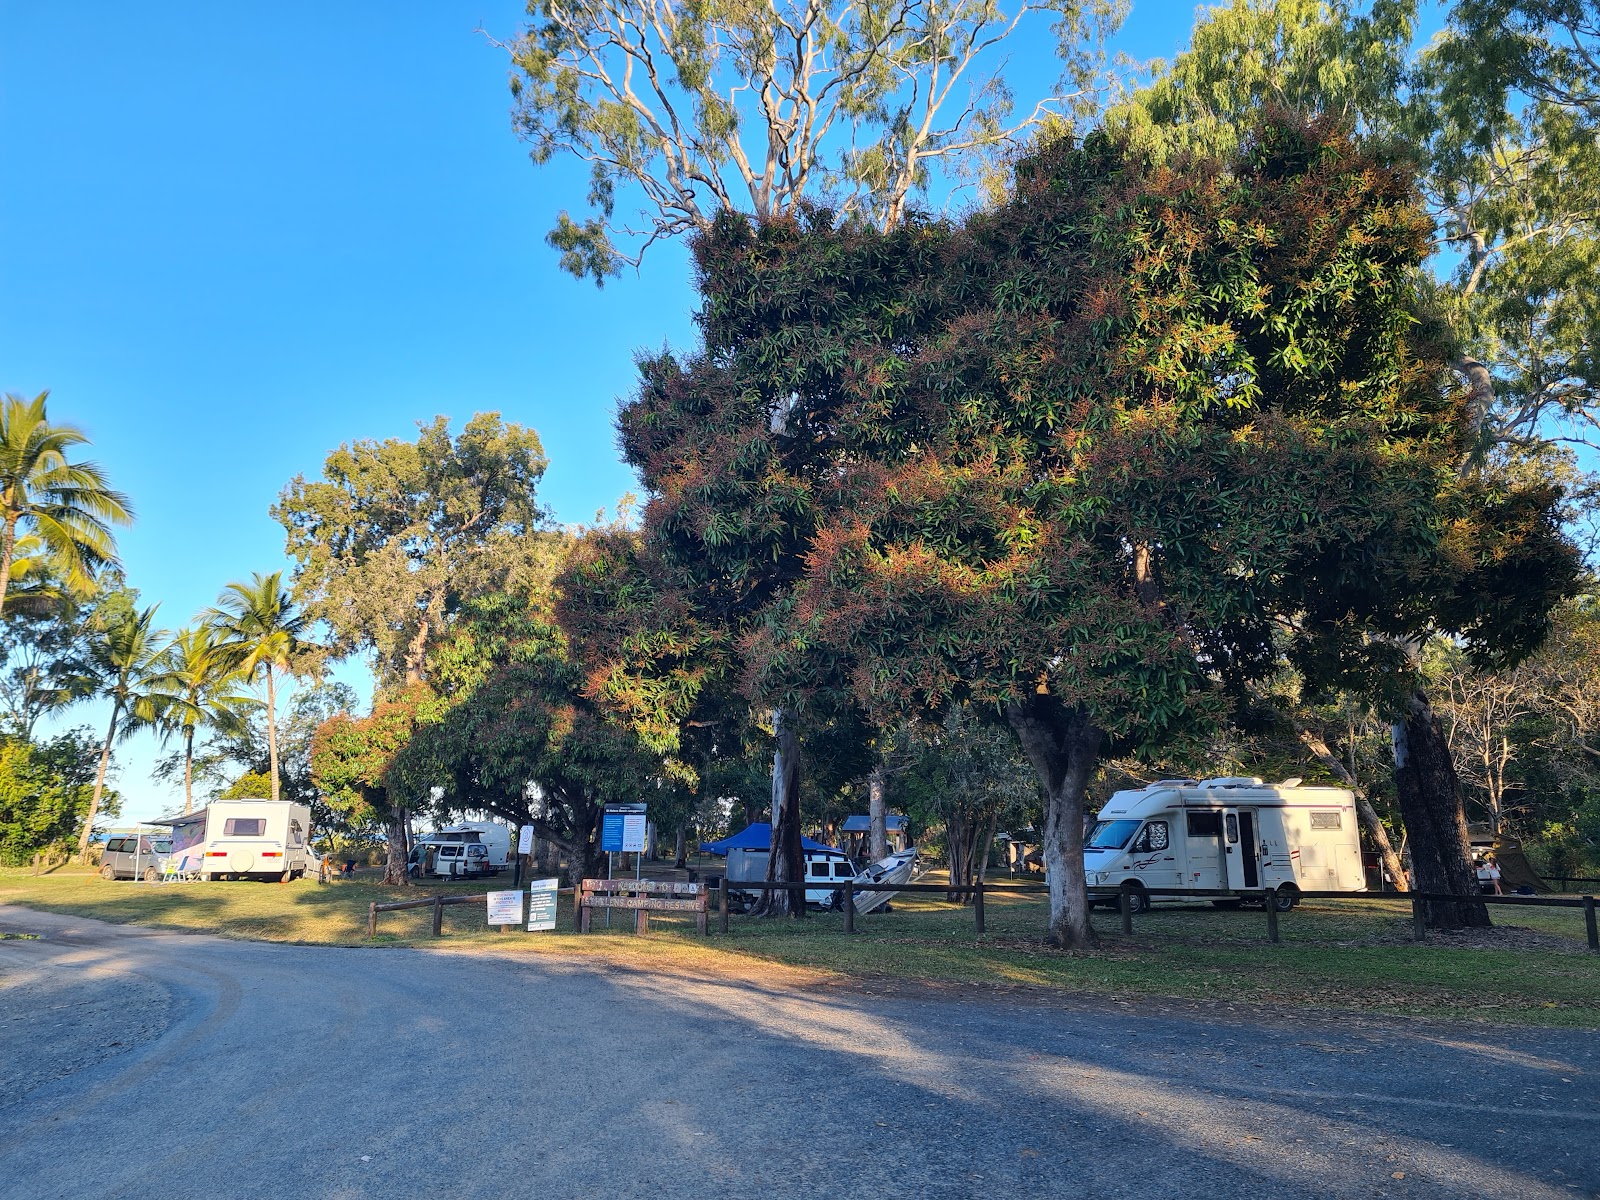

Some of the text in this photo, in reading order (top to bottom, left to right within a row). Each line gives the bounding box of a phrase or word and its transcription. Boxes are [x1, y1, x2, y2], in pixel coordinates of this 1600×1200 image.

[659, 882, 668, 891] TO
[595, 897, 624, 907] HELENS
[627, 899, 661, 909] CAMPING
[664, 901, 701, 910] RESERVE
